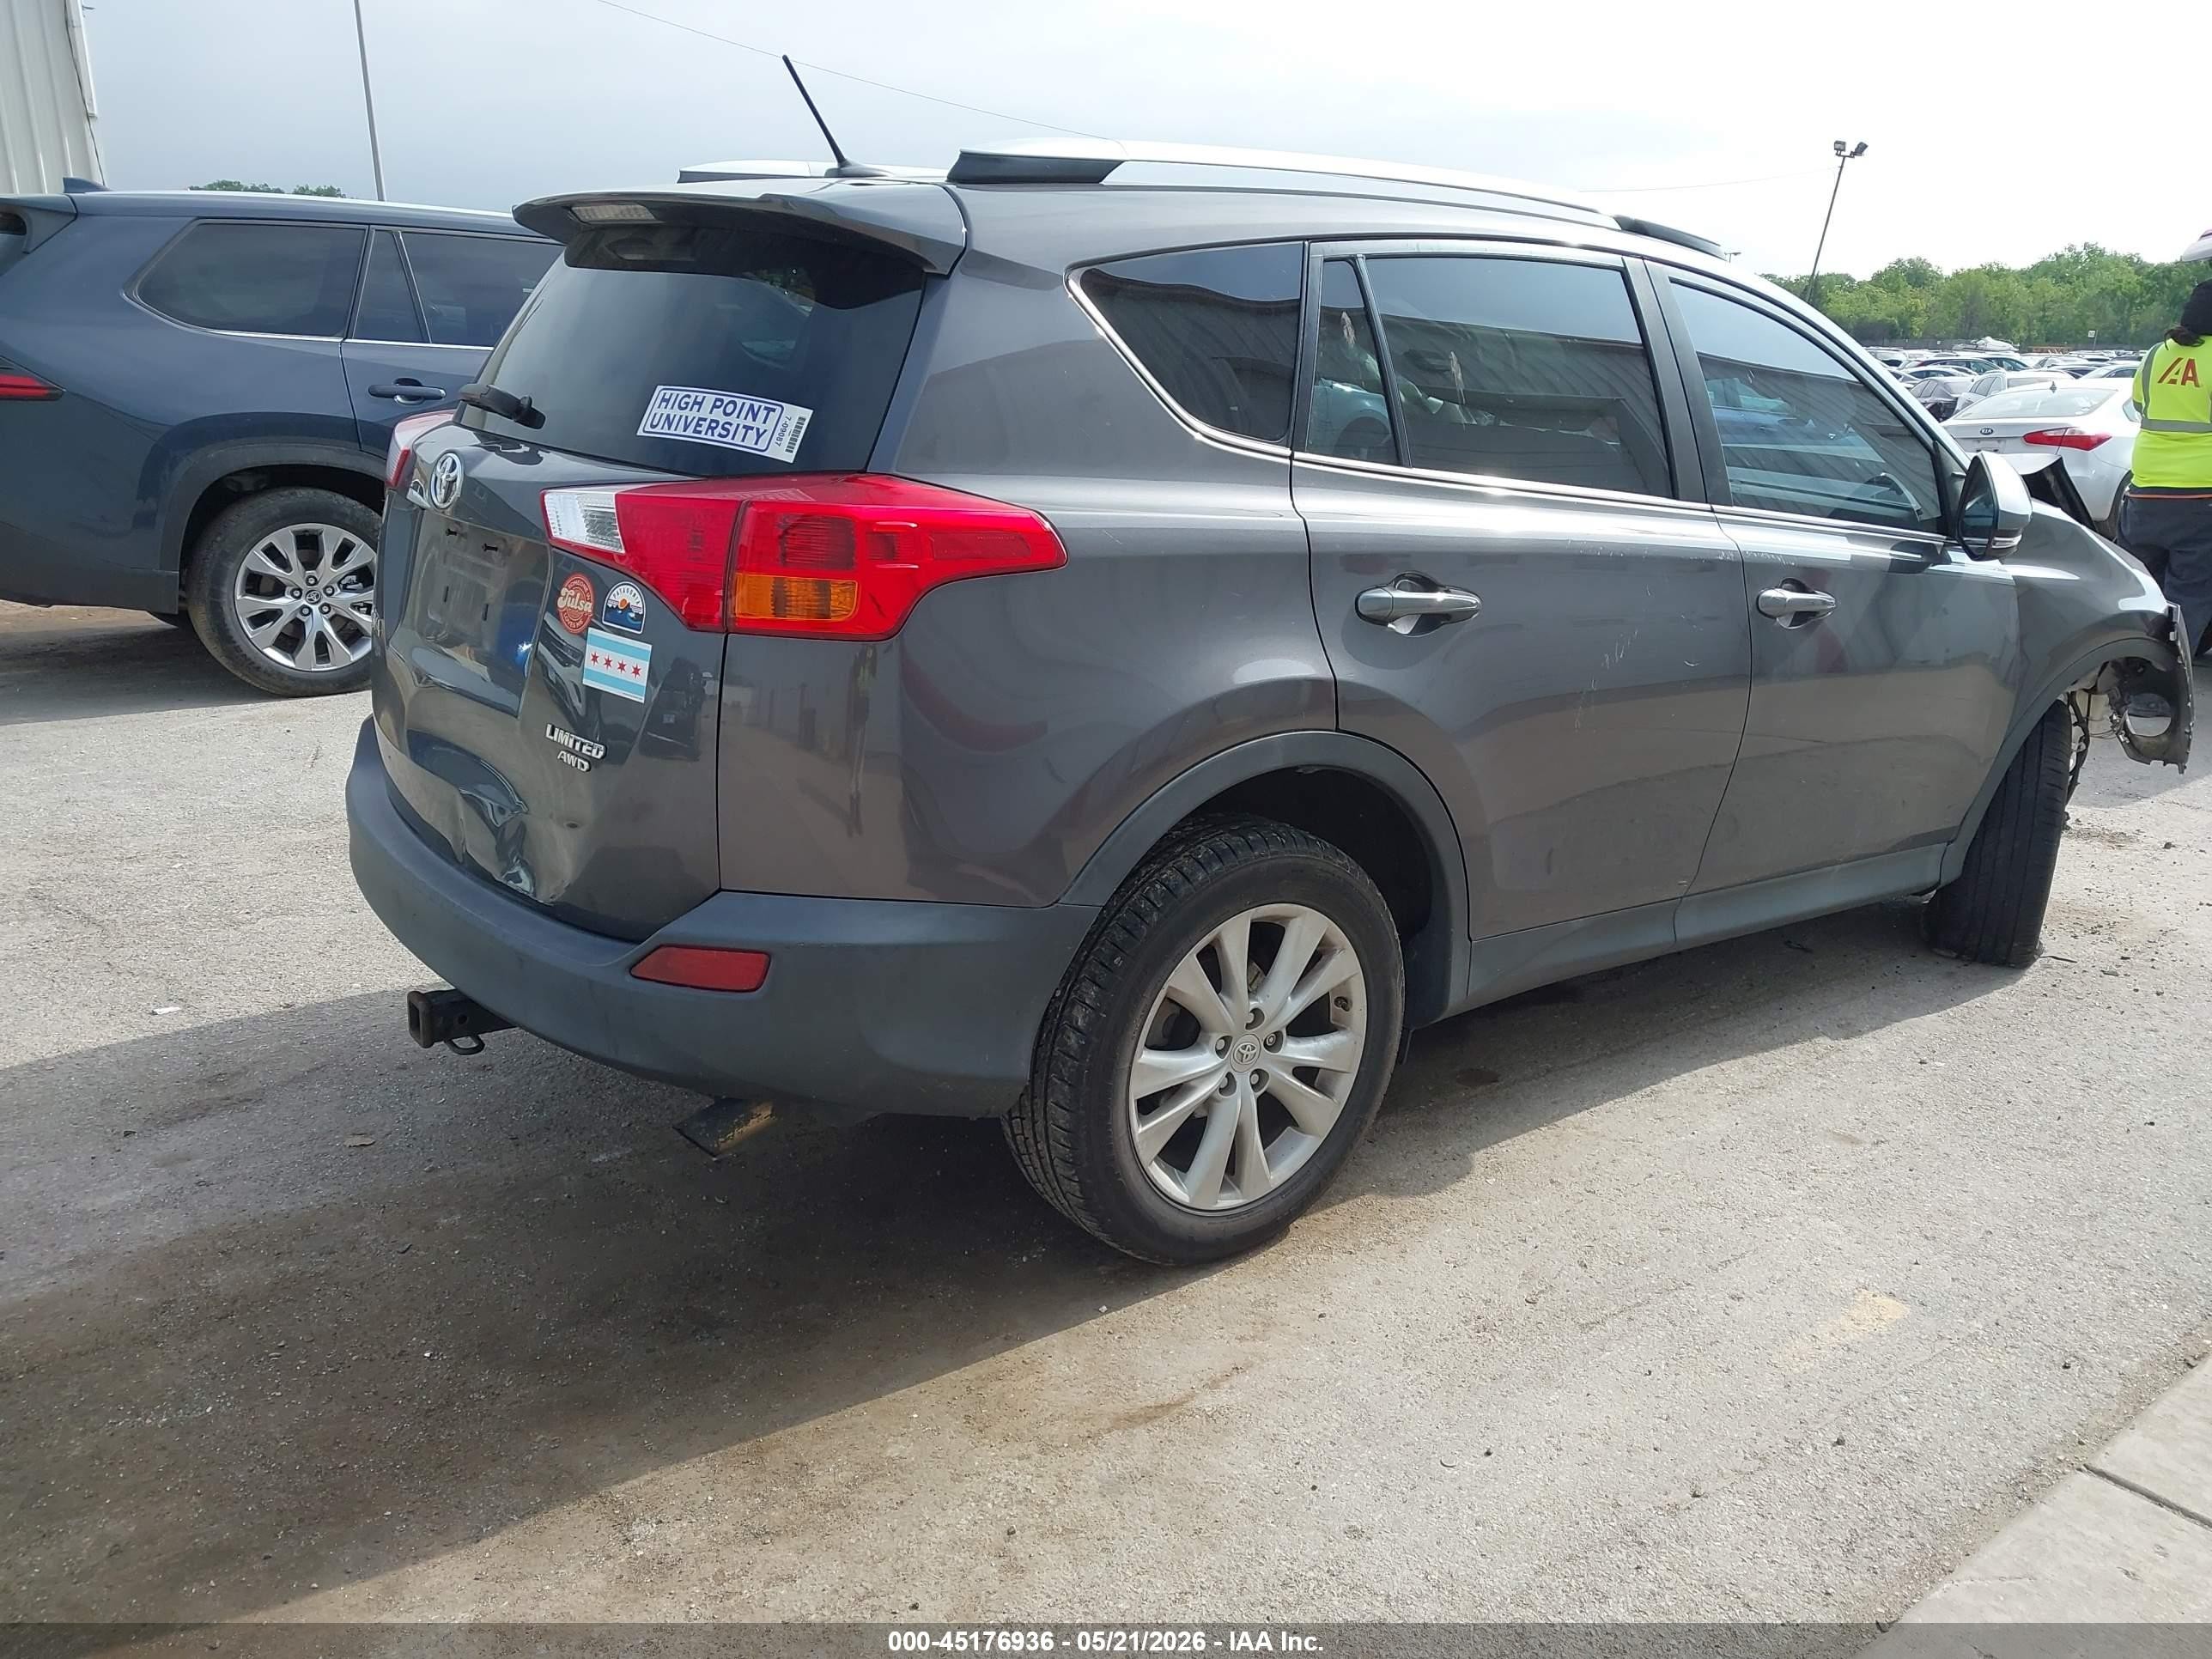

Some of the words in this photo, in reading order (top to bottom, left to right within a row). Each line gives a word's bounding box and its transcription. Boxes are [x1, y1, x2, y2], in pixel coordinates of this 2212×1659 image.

[657, 392, 706, 413] HIGH
[708, 397, 777, 425] POINT
[649, 412, 768, 446] UNIVERSITY
[775, 416, 792, 447] 7-09087
[557, 587, 593, 613] Tulsa
[612, 587, 641, 605] PATAGONIA
[545, 723, 606, 760] LIMITED
[557, 750, 590, 773] AWD
